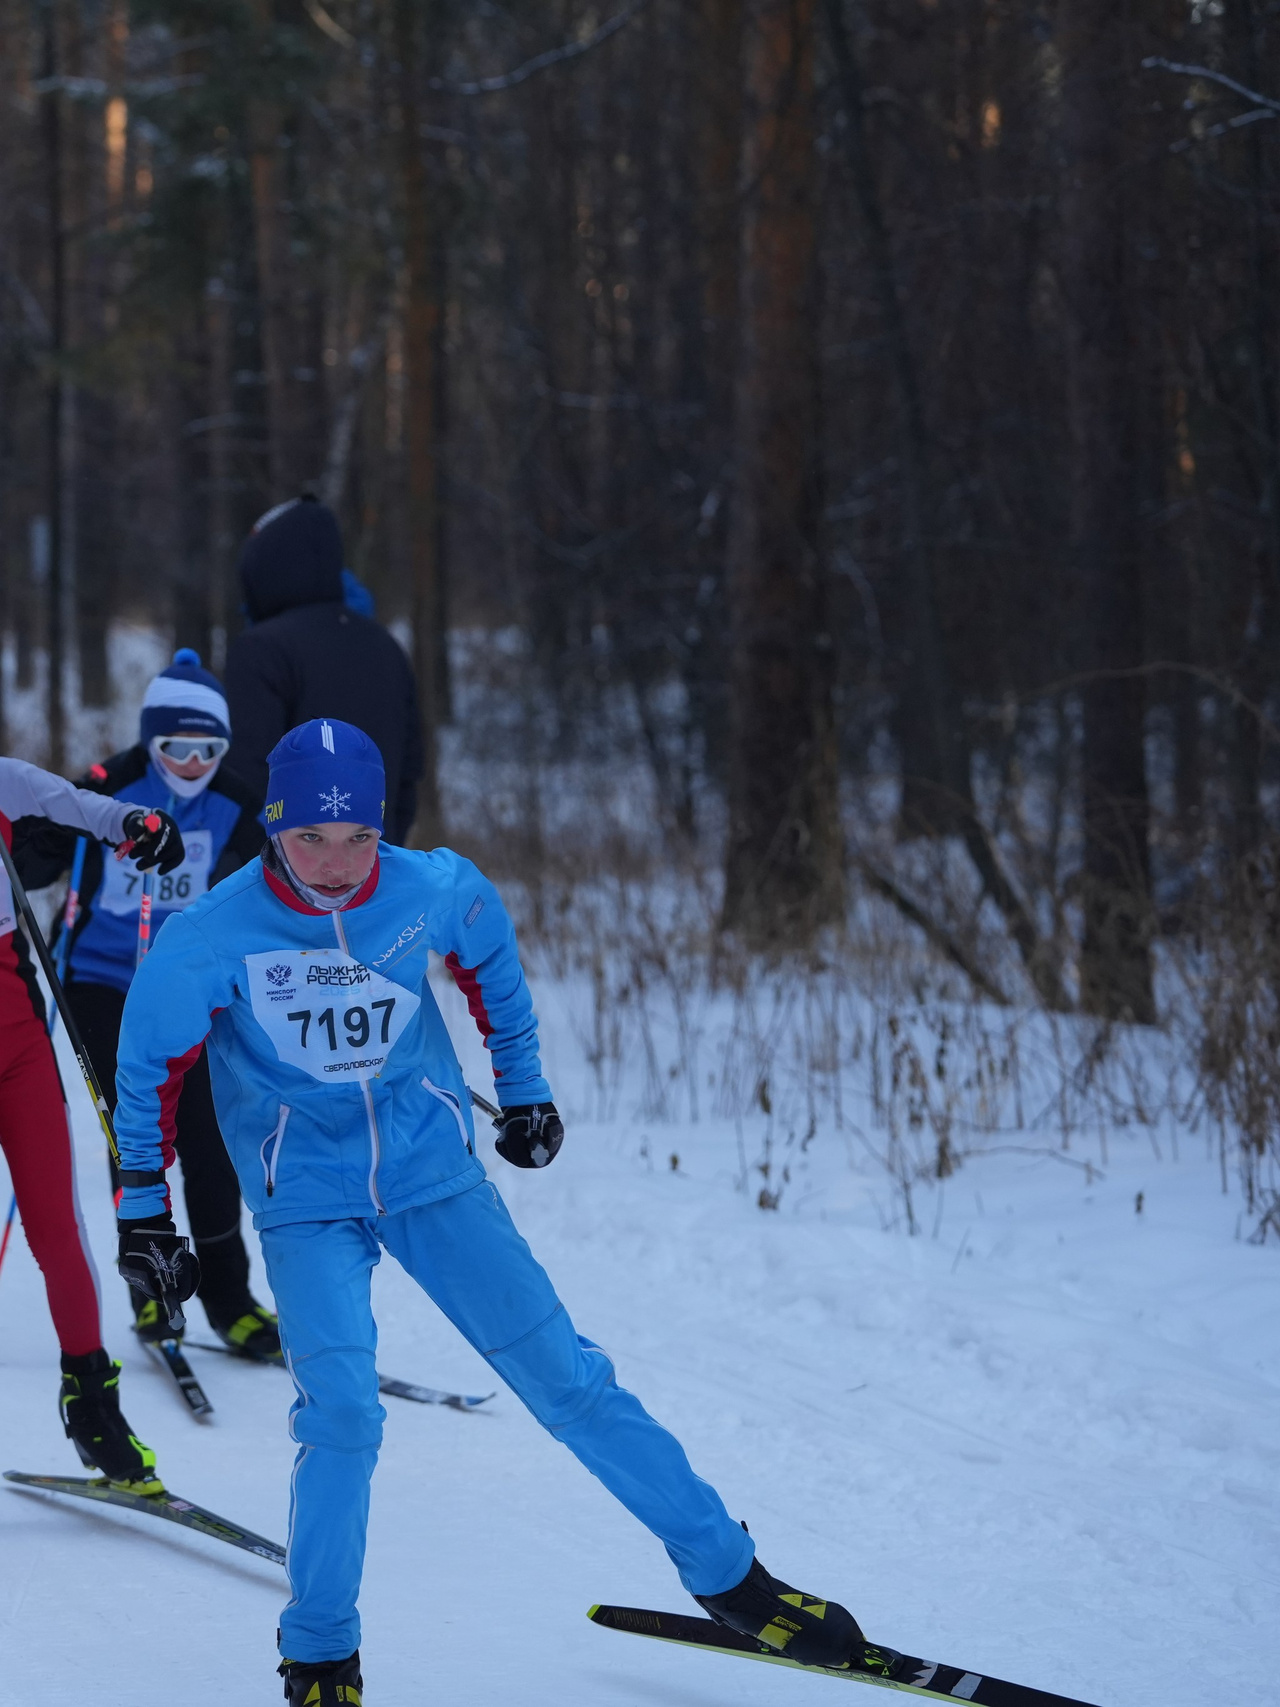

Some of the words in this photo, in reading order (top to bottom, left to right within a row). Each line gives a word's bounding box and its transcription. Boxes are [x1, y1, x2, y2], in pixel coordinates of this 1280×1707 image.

[123, 872, 191, 902] 786
[308, 964, 368, 976] ЛЫЖНЯ
[306, 973, 371, 986] РОССИИ
[266, 988, 297, 996] МИНСПОРТ
[287, 998, 396, 1051] 7197
